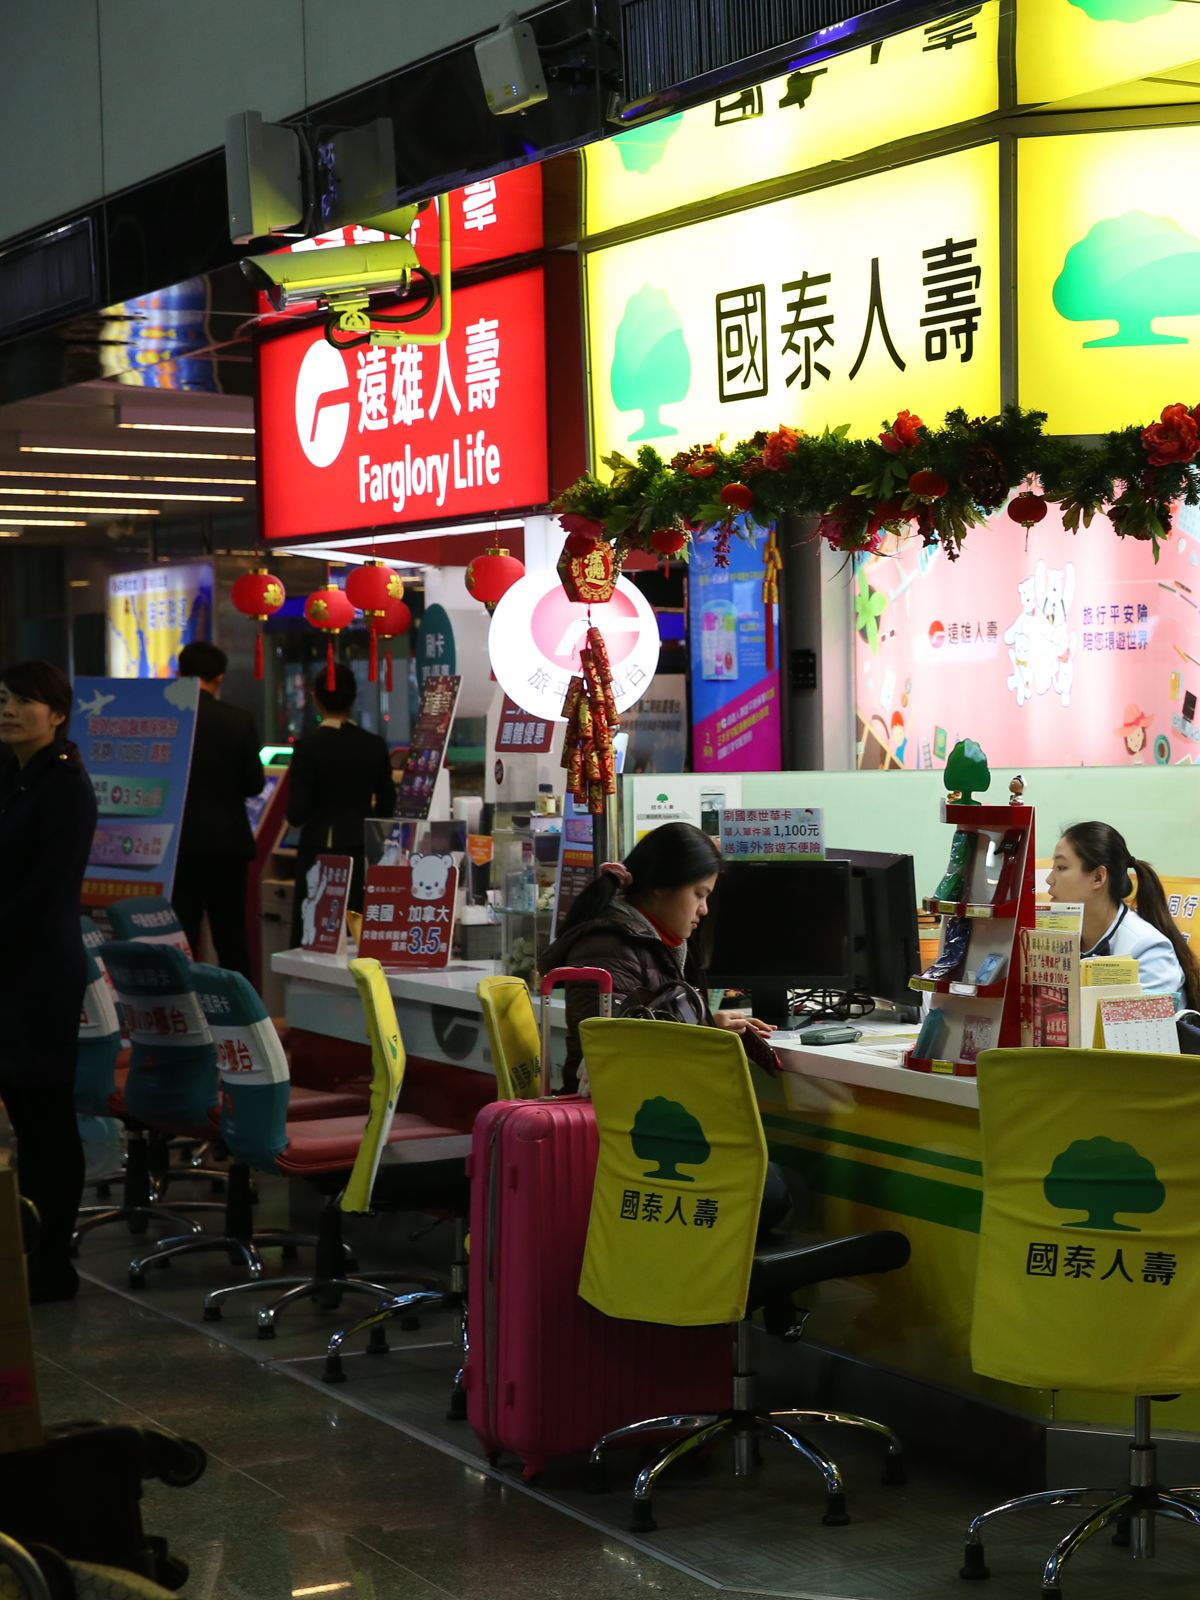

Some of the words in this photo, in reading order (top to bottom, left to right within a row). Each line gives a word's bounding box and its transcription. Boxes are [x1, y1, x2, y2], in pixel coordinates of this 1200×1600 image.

[716, 237, 981, 403] 國泰人壽
[356, 317, 501, 434] 遠雄人壽
[358, 443, 450, 513] Farglory
[453, 431, 501, 490] Life
[947, 620, 999, 645] 遠雄人壽
[1082, 603, 1149, 625] 旅行平安險
[365, 904, 450, 922] 美國、加拿大
[407, 926, 441, 954] 3.5
[619, 1189, 719, 1229] 國泰人壽
[1026, 1241, 1177, 1287] 國泰人壽
